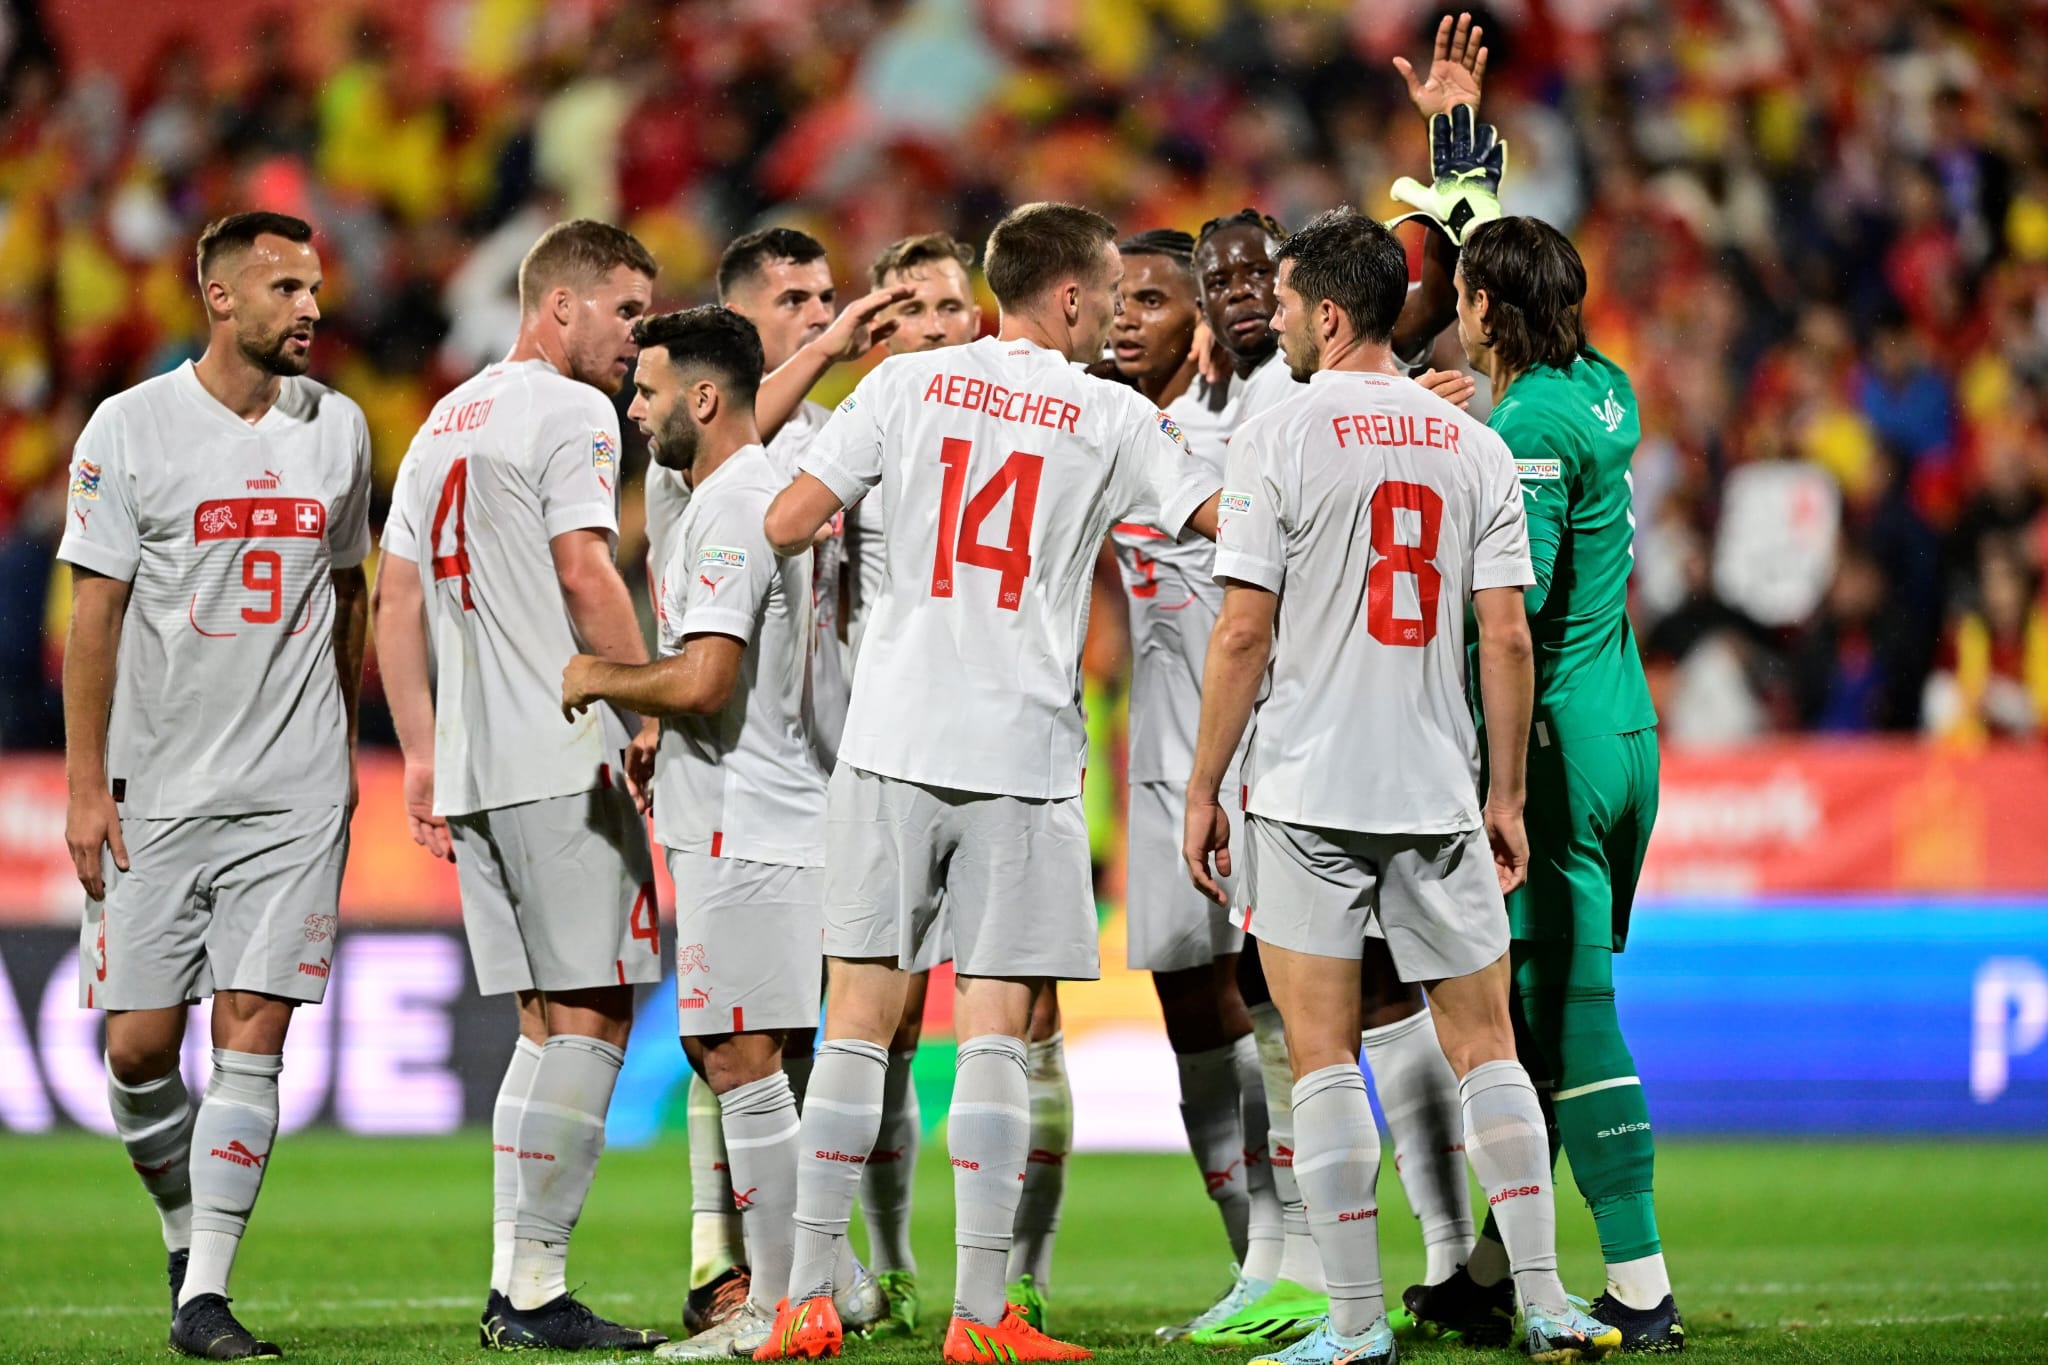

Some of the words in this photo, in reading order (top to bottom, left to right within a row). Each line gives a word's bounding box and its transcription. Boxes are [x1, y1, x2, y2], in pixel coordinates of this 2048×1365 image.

[923, 373, 1081, 434] AEBISCHER
[1332, 414, 1459, 454] FREULER
[431, 456, 475, 611] 4
[931, 437, 1044, 611] 14
[241, 550, 282, 624] 9
[1367, 480, 1443, 647] 8
[630, 880, 660, 955] 4
[298, 962, 327, 978] PUMA
[210, 1148, 252, 1168] PUMA
[1596, 1122, 1651, 1138] suisse
[1489, 1184, 1540, 1206] suisse
